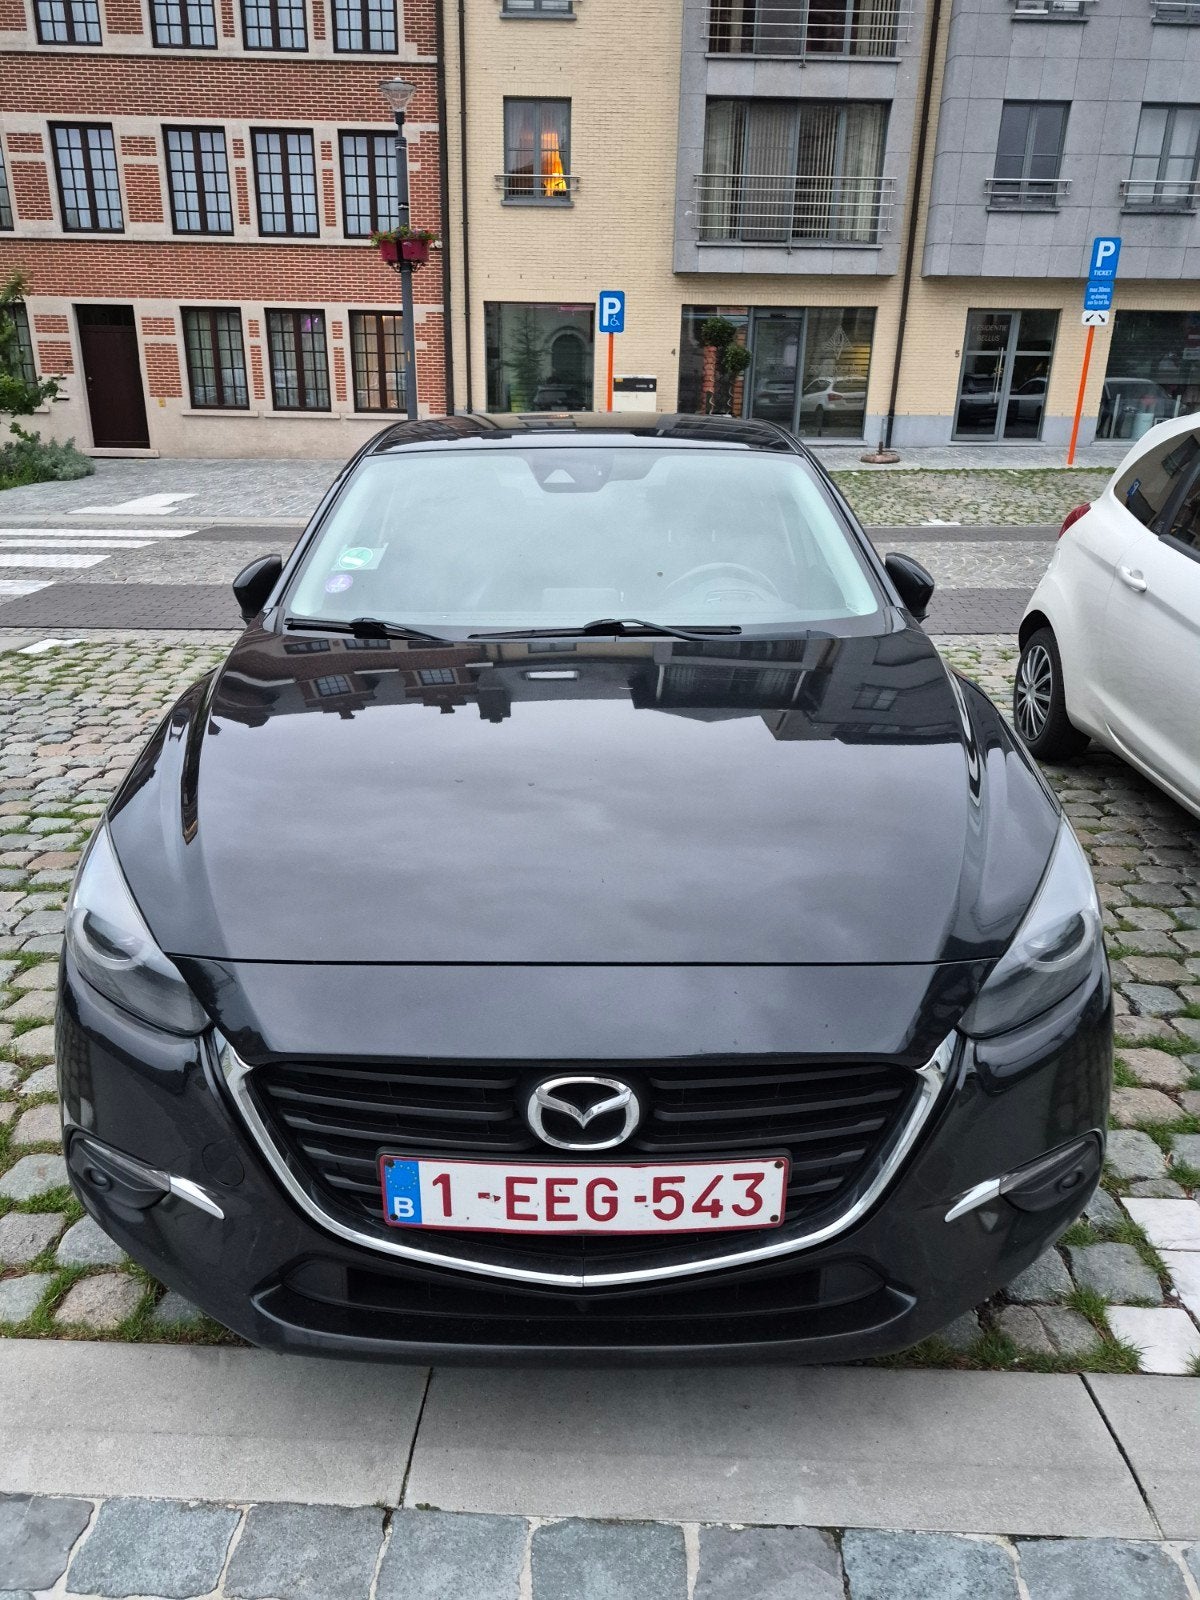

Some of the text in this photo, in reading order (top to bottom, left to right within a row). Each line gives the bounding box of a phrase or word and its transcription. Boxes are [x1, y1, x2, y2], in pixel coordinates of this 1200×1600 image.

[1096, 241, 1116, 268] P
[603, 297, 621, 326] P
[671, 348, 676, 356] 4
[954, 350, 960, 358] 5
[393, 1196, 415, 1218] B
[432, 1172, 765, 1221] 1-EEG-543
